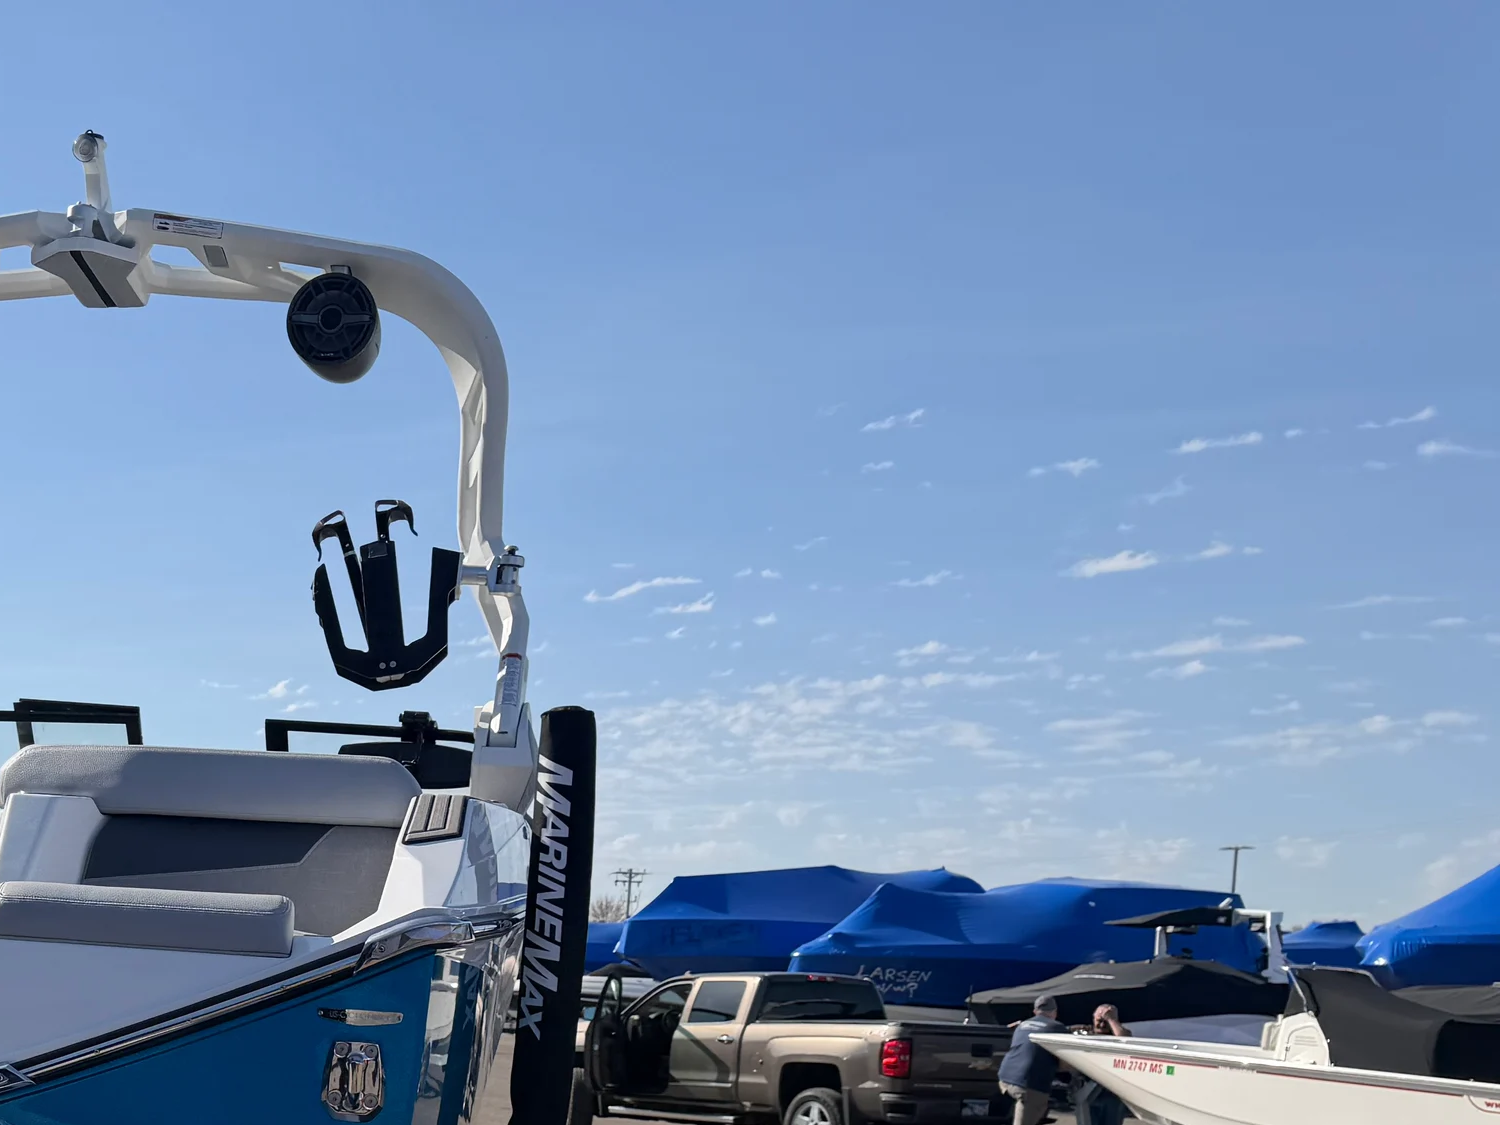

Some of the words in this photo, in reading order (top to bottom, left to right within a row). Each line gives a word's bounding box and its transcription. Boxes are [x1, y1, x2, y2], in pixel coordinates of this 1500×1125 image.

[854, 964, 932, 983] LARSEN
[1113, 1058, 1127, 1070] MN
[1128, 1060, 1147, 1073] 2747
[1149, 1063, 1163, 1075] MS
